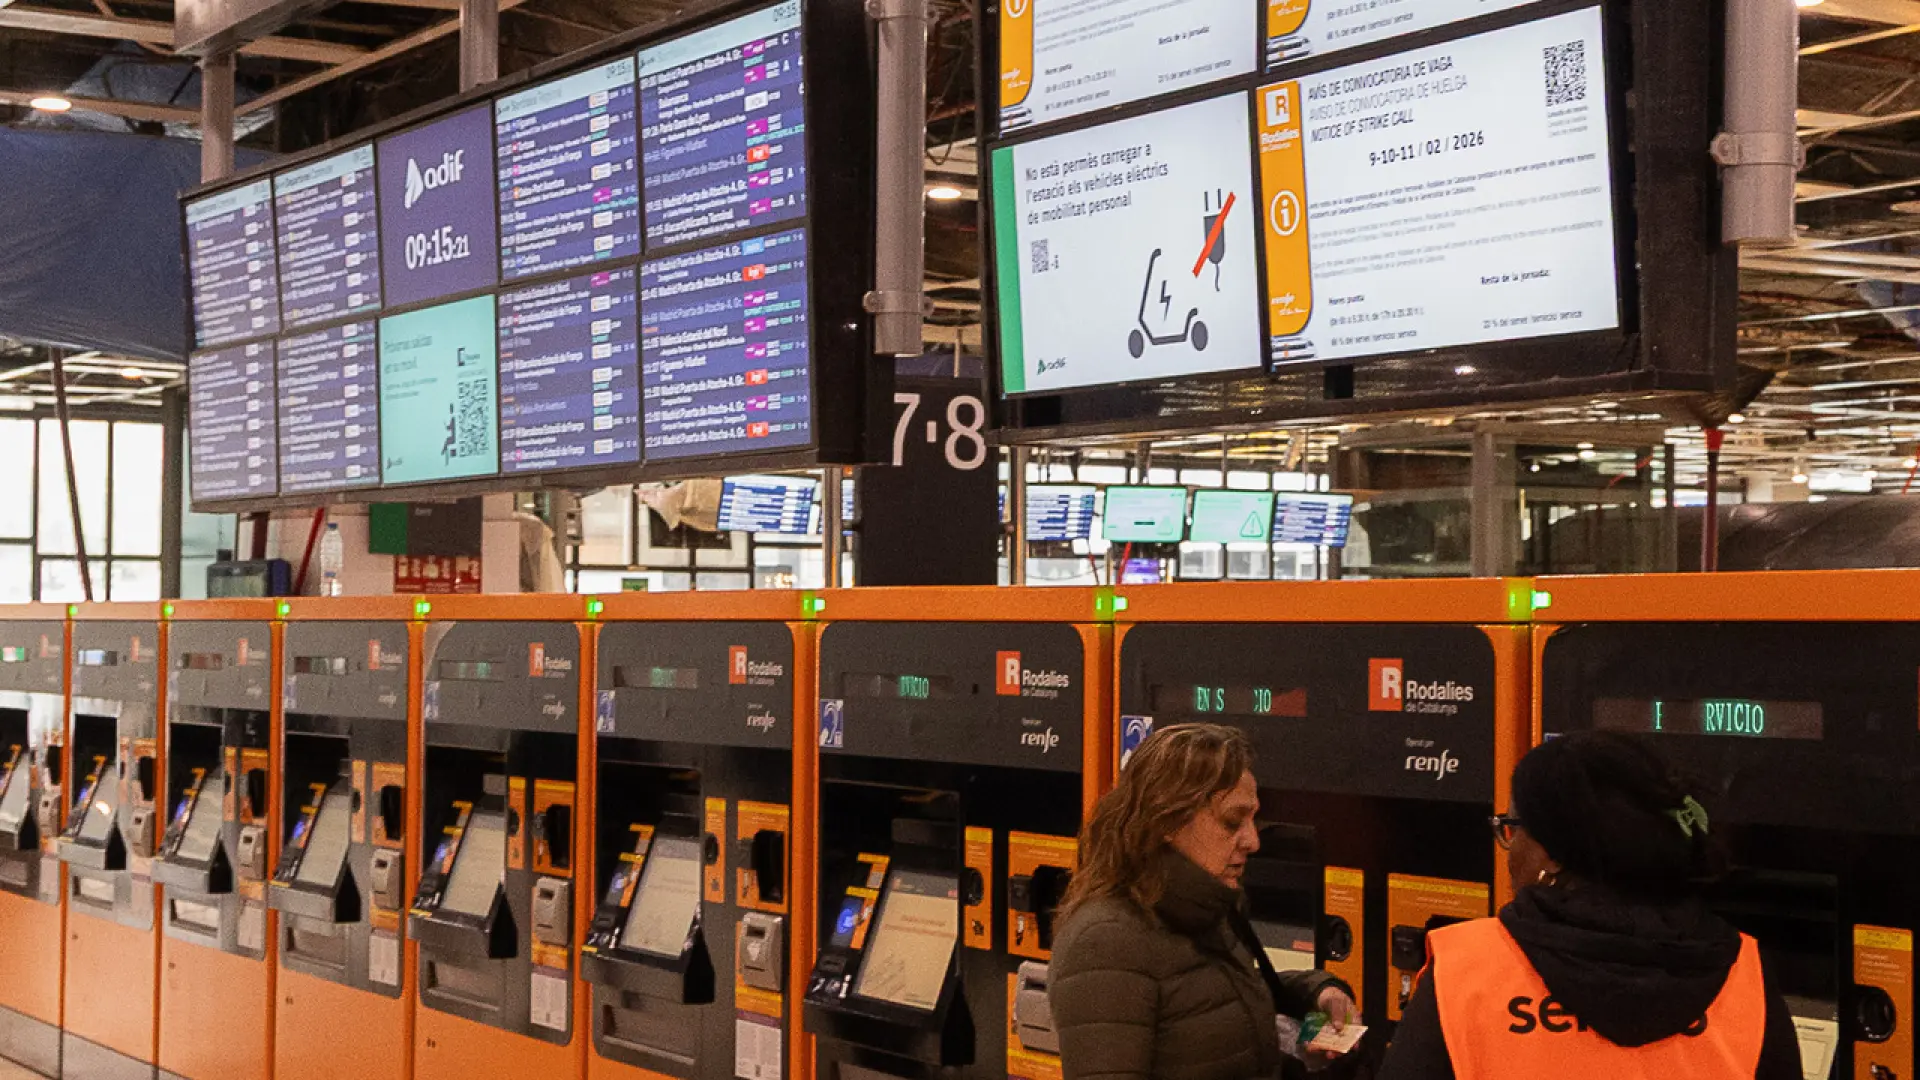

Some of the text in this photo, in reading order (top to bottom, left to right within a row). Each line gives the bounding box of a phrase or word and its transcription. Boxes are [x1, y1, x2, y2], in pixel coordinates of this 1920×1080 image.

[1328, 80, 1340, 97] DE
[1343, 63, 1410, 94] CONVOCATORIA
[1413, 59, 1425, 77] DE
[1427, 52, 1452, 74] VAGA
[1334, 100, 1345, 117] DE
[1348, 84, 1414, 114] CONVOCATORIA
[1416, 80, 1429, 98] DE
[1430, 71, 1468, 95] HUELGA
[1311, 107, 1413, 143] NOTICE OF STRIKE CALL
[1026, 143, 1152, 181] No està permès carregar a
[1368, 143, 1414, 167] 9-10-11
[1425, 138, 1441, 156] 02
[1452, 129, 1484, 151] 2026
[424, 150, 465, 190] adif
[1068, 181, 1081, 196] els
[1084, 171, 1123, 192] vehicles
[1126, 161, 1169, 183] elèctrics
[1027, 191, 1132, 225] de mobilitat personal
[748, 661, 783, 676] Rodalies
[1005, 658, 1020, 685] R
[1022, 669, 1069, 688] Rodalies
[1382, 667, 1401, 698] R
[1406, 680, 1474, 701] Rodalies
[747, 711, 776, 733] renfe
[1020, 726, 1060, 753] renfe
[1404, 749, 1460, 780] renfe
